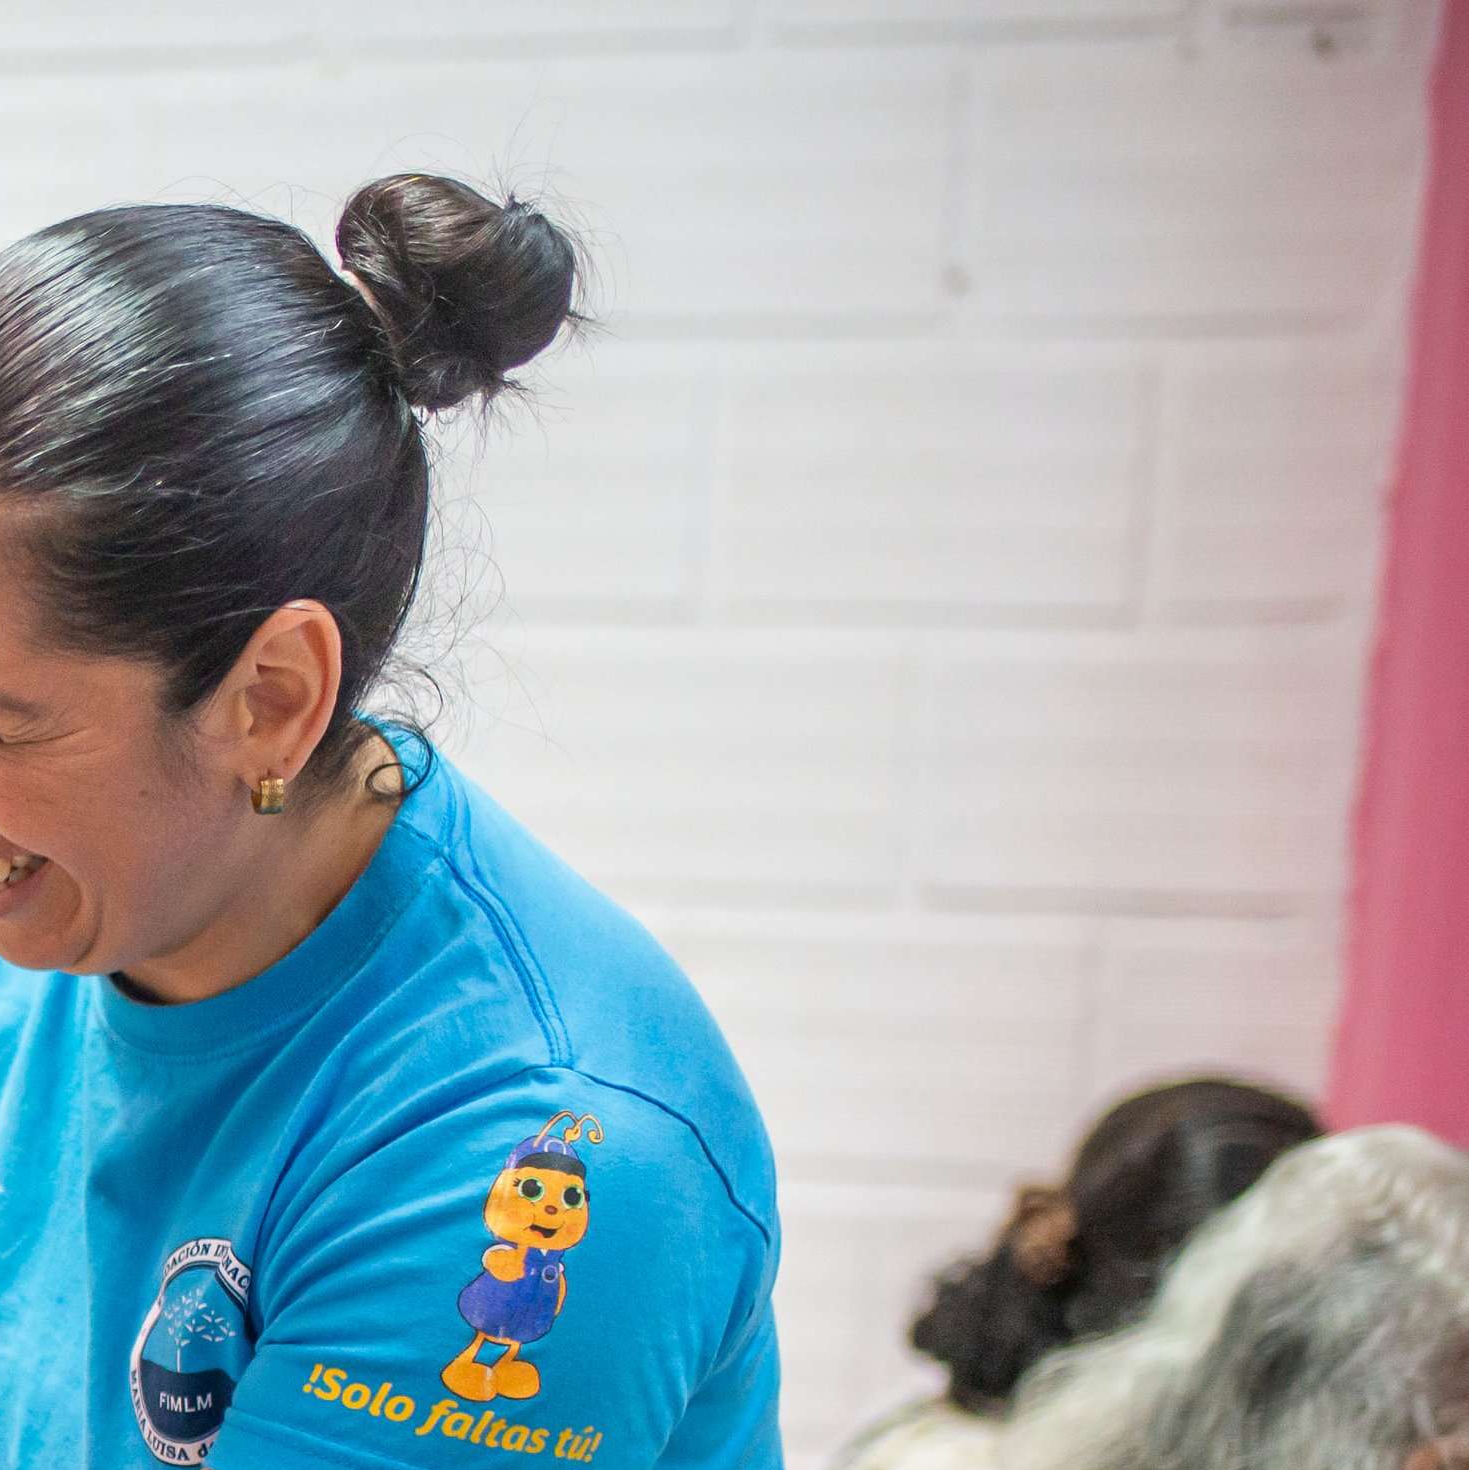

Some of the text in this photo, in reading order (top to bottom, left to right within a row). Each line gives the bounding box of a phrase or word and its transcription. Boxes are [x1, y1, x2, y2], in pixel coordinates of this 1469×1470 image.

[159, 1391, 214, 1414] FIMLM
[146, 1429, 191, 1462] LUISA
[197, 1441, 215, 1459] d
[415, 1399, 550, 1454] faltas
[554, 1425, 603, 1463] tú!
